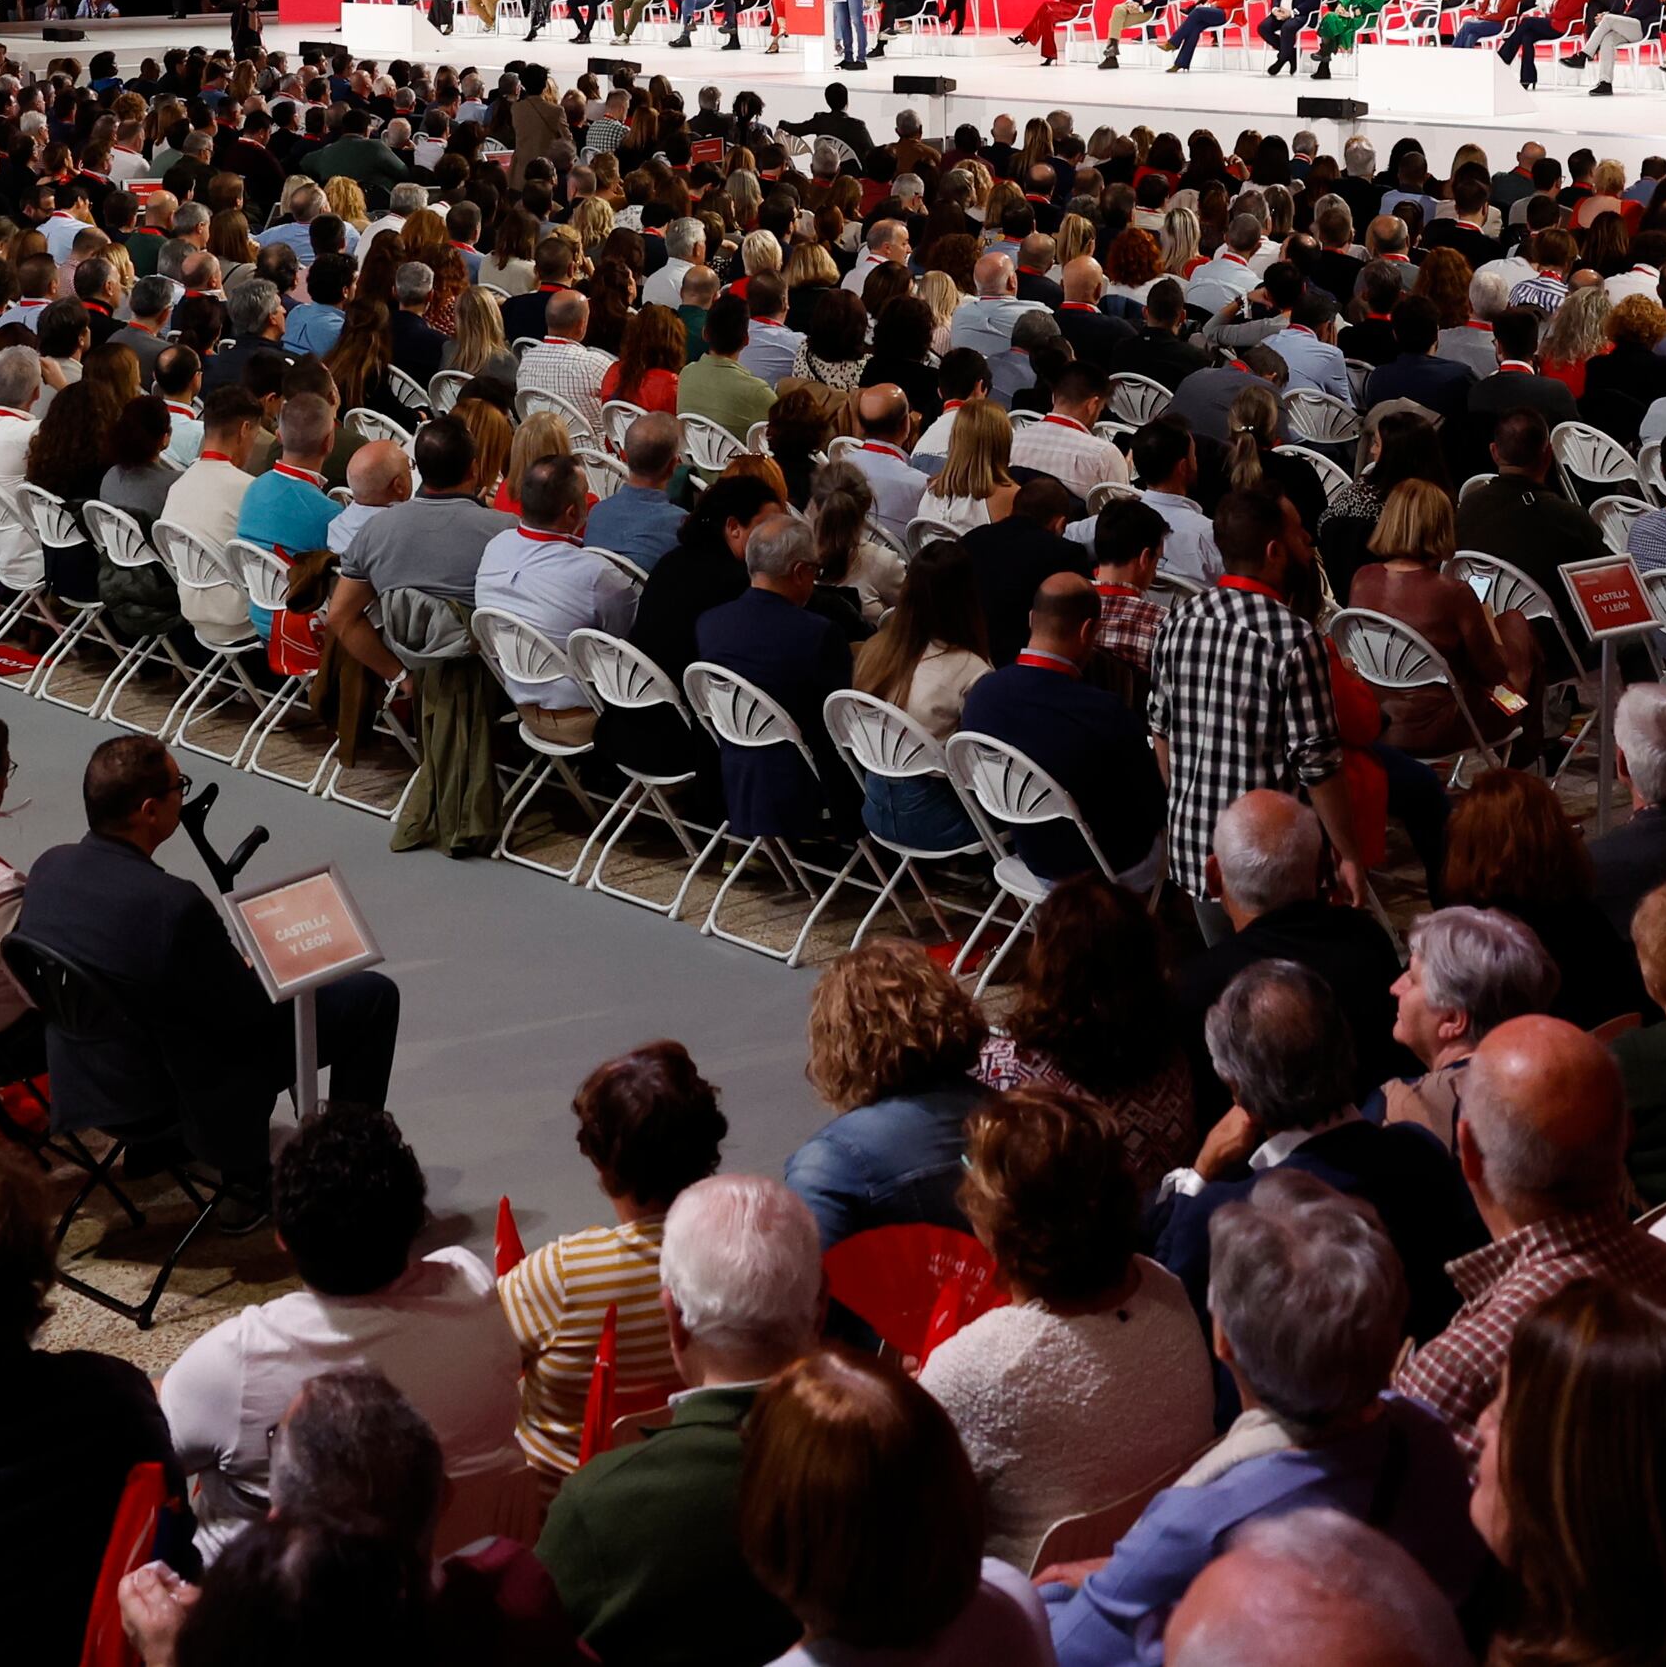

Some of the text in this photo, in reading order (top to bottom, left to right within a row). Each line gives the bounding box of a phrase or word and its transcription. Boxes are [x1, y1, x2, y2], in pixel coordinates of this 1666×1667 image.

[1592, 590, 1630, 603] CASTILLA
[1601, 601, 1631, 614] Y LEÓN
[275, 914, 331, 942] CASTILLA
[288, 944, 299, 955] Y
